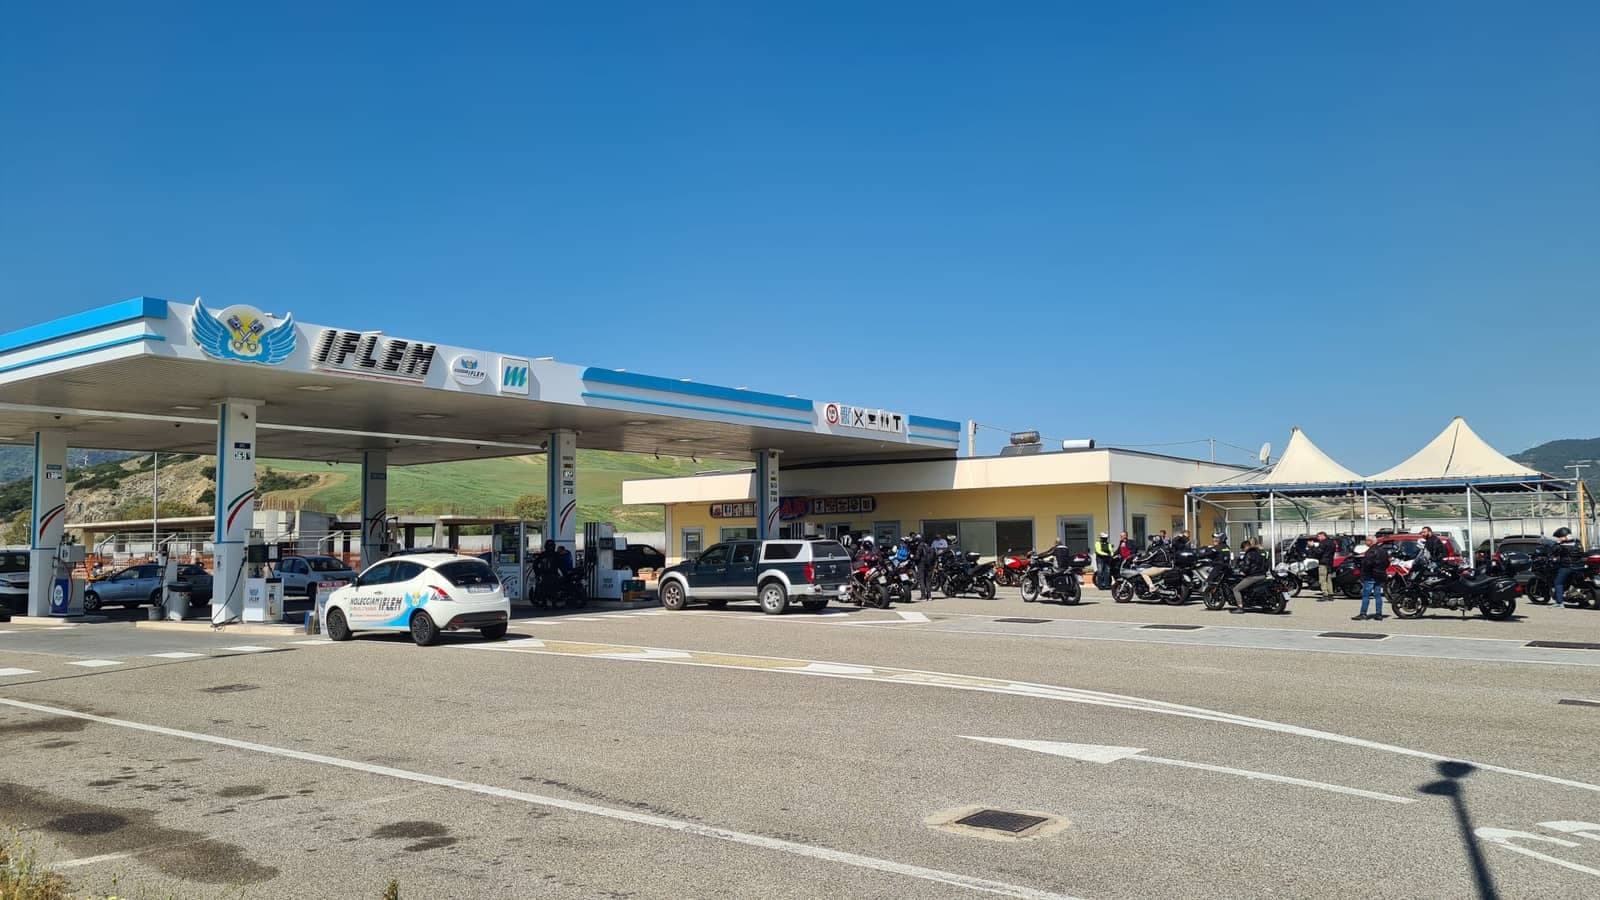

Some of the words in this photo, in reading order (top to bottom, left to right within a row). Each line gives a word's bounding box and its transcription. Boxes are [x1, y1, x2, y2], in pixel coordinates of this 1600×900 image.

[313, 329, 437, 376] IFLEM
[892, 415, 902, 431] T
[782, 500, 805, 516] AR
